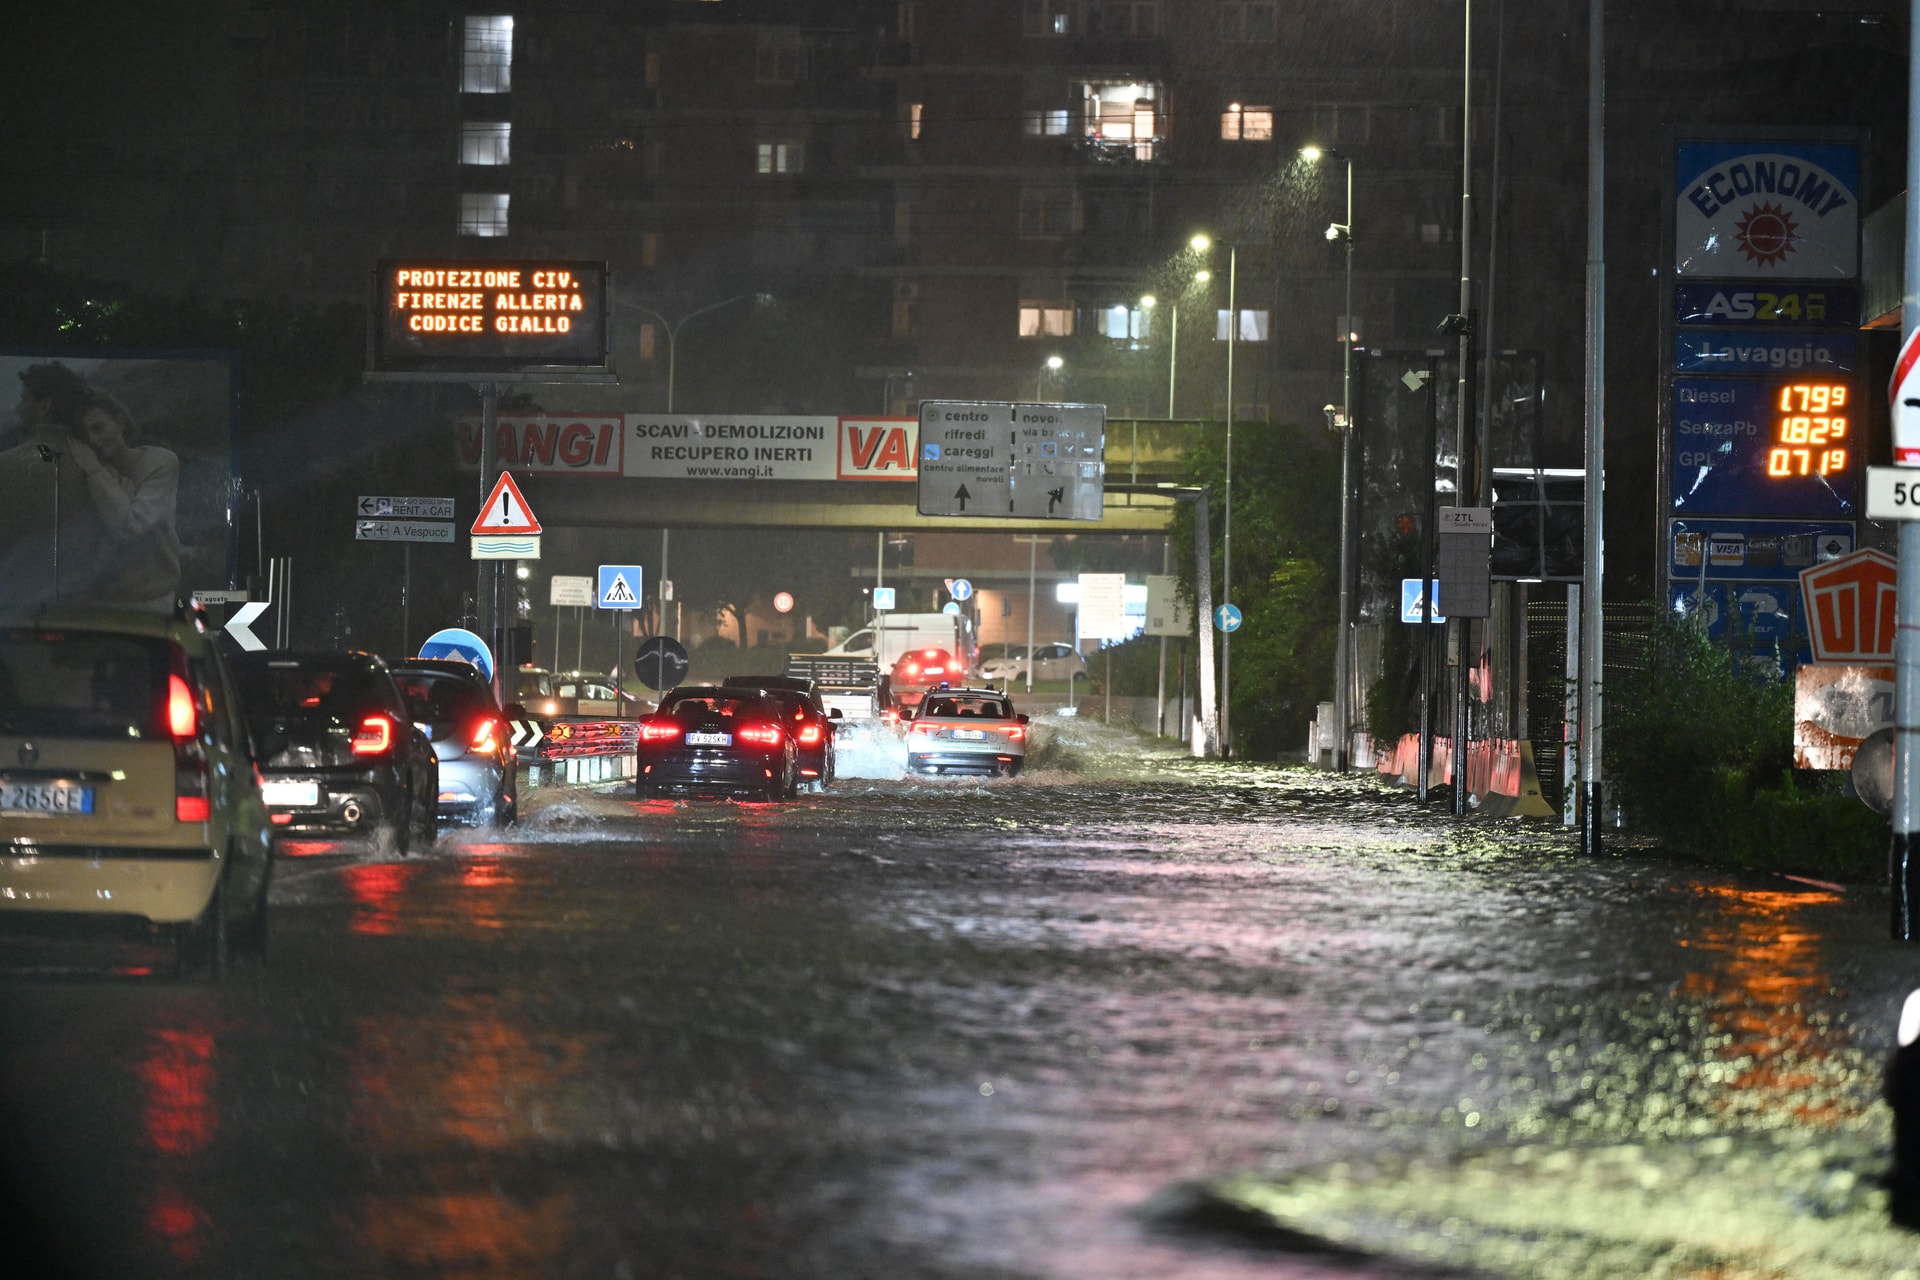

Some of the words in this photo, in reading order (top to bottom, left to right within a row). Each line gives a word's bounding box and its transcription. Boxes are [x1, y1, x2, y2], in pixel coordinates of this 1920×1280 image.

[1688, 161, 1847, 219] ECONOMY
[398, 271, 520, 287] PROTEZIONE
[533, 271, 579, 288] CIV.
[398, 293, 484, 309] FIRENZE
[496, 294, 582, 310] ALLERTA
[1704, 292, 1801, 320] AS24
[410, 315, 484, 331] CODICE
[495, 316, 571, 332] GIALLO
[1702, 342, 1831, 368] Lavaggio
[1679, 388, 1736, 403] Diesel
[945, 411, 989, 422] centro
[636, 425, 688, 438] SCAVI
[705, 425, 824, 440] DEMOLIZIONI
[944, 429, 985, 440] rifredi
[1023, 428, 1037, 437] via
[1679, 420, 1757, 435] SenzaPb
[459, 422, 614, 467] VANGI
[848, 427, 919, 470] VA
[651, 446, 749, 460] RECUPERO
[755, 447, 812, 461] INERTI
[944, 446, 994, 459] careggi
[1679, 452, 1717, 467] GPL
[687, 465, 774, 479] www.vangi.it
[956, 464, 1004, 473] alimentare
[975, 475, 1004, 483] novoli
[392, 505, 420, 515] RENT
[430, 506, 452, 516] CAR
[1454, 513, 1474, 522] ZTL
[1716, 545, 1740, 554] VISA
